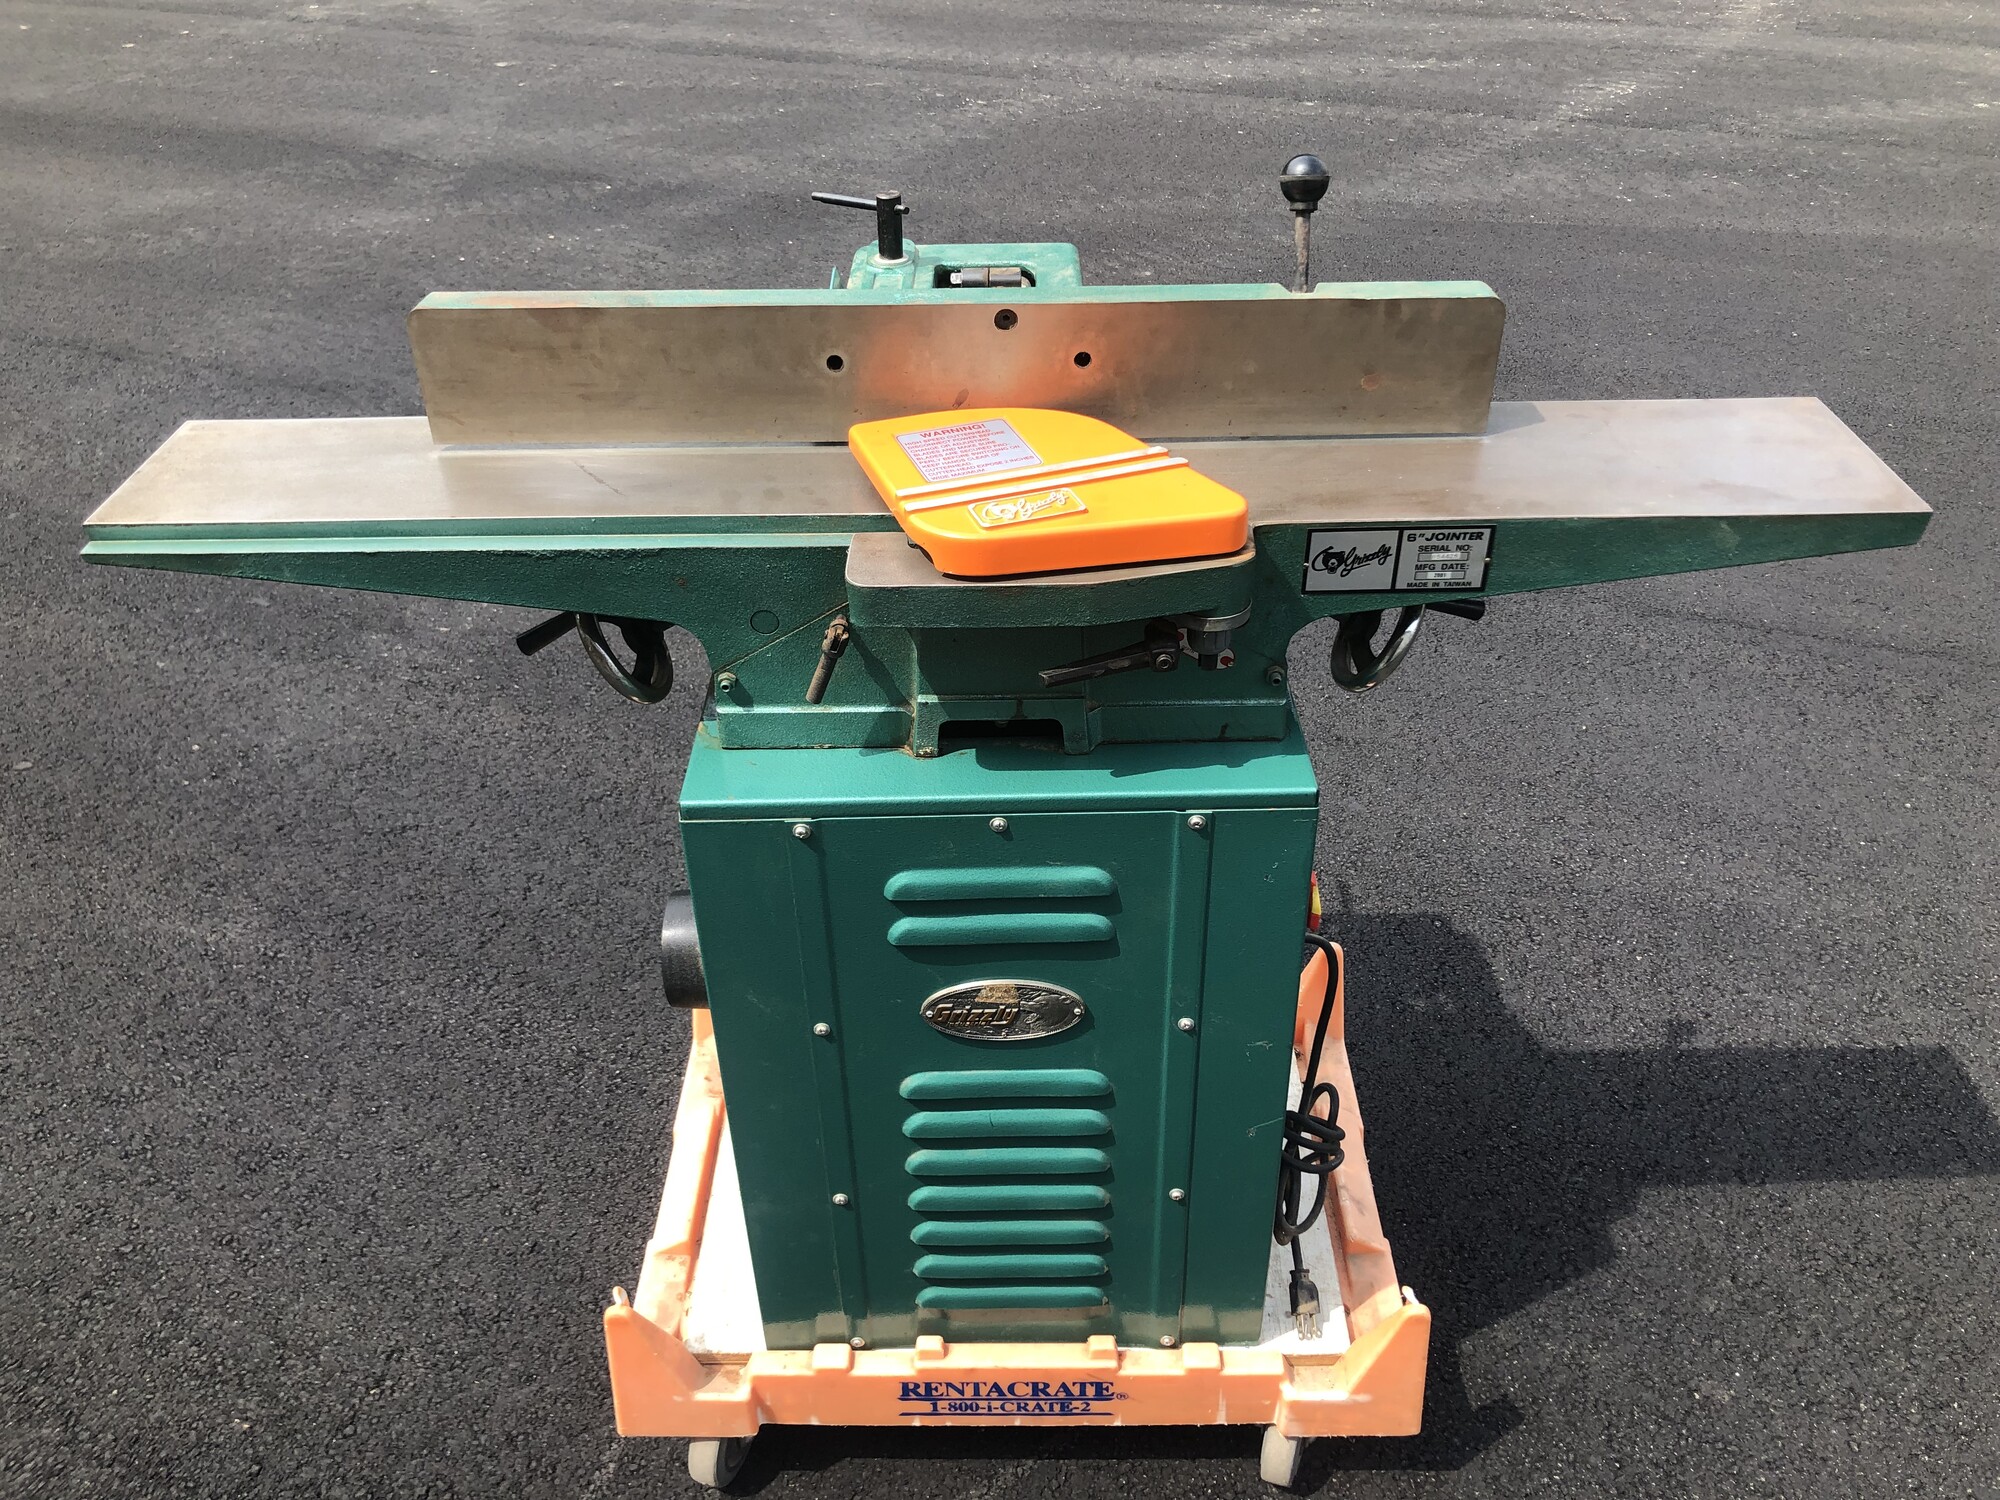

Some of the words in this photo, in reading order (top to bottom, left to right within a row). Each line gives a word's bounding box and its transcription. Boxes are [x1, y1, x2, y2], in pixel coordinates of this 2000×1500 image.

[920, 424, 986, 438] WARNING!
[1455, 544, 1474, 552] NO:
[1415, 563, 1436, 571] MFG
[1441, 563, 1470, 571] DATE:
[933, 1003, 1019, 1026] Grizzly
[900, 1382, 1115, 1397] RENTACRATE
